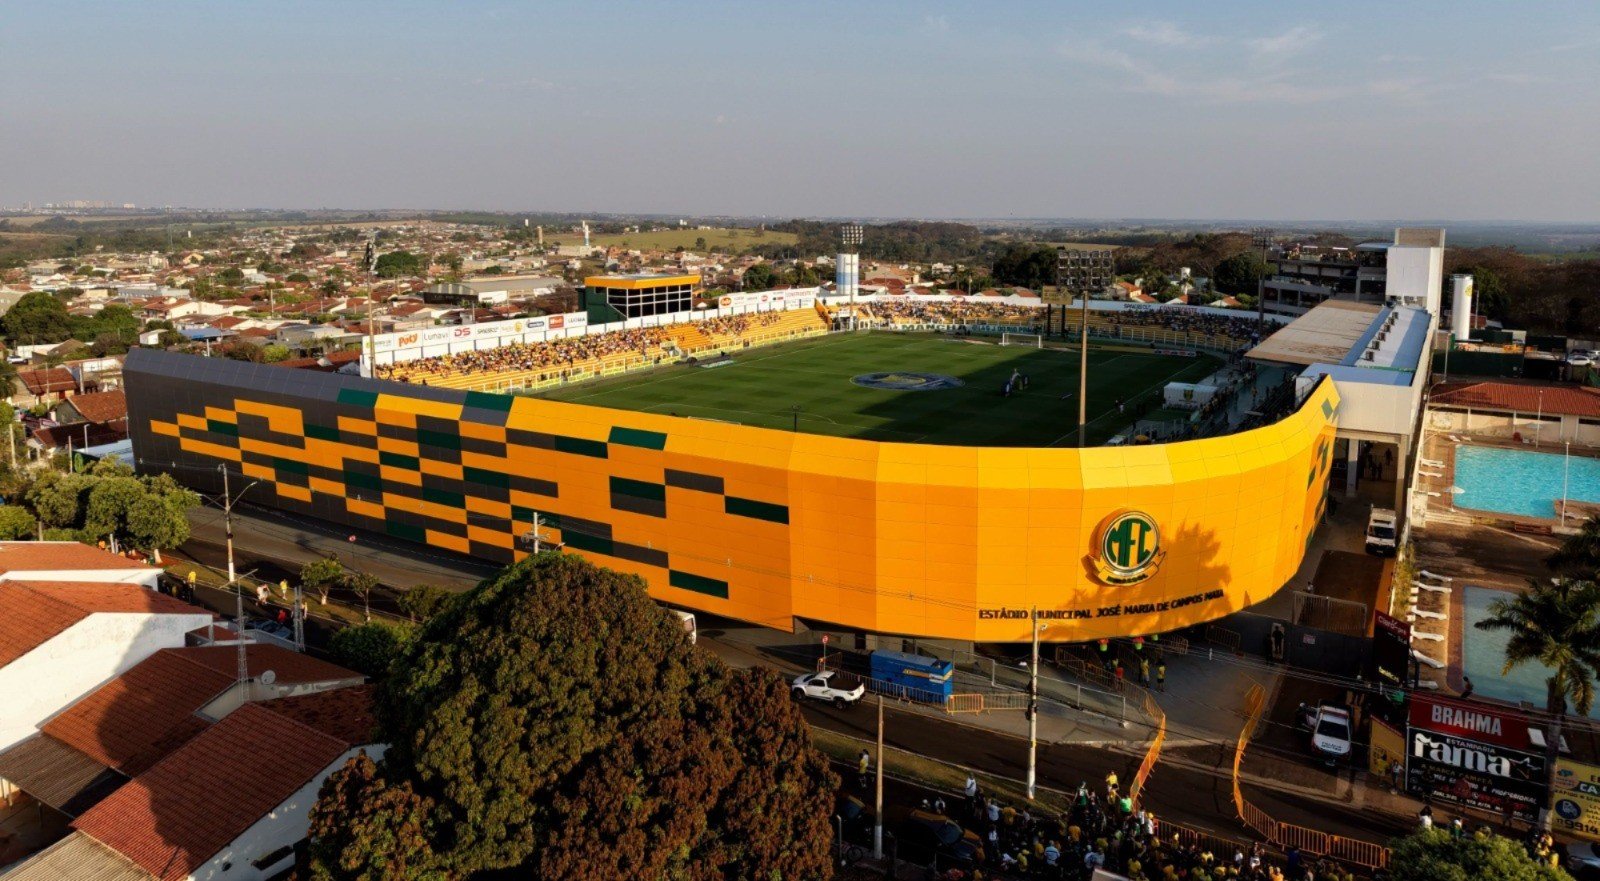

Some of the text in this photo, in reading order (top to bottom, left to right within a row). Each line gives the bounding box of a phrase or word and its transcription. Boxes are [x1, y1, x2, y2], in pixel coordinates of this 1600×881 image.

[454, 327, 471, 337] DS
[1105, 517, 1152, 567] MFC
[978, 607, 1028, 619] ESTÁDIO
[1096, 604, 1121, 616] JOSÉ
[1123, 603, 1155, 615] MARIA
[1156, 601, 1170, 613] DE
[1170, 593, 1204, 609] CAMPOS
[1431, 704, 1502, 736] BRAHMA
[1414, 731, 1512, 778] rama
[1446, 737, 1496, 754] ESTAMPARIA
